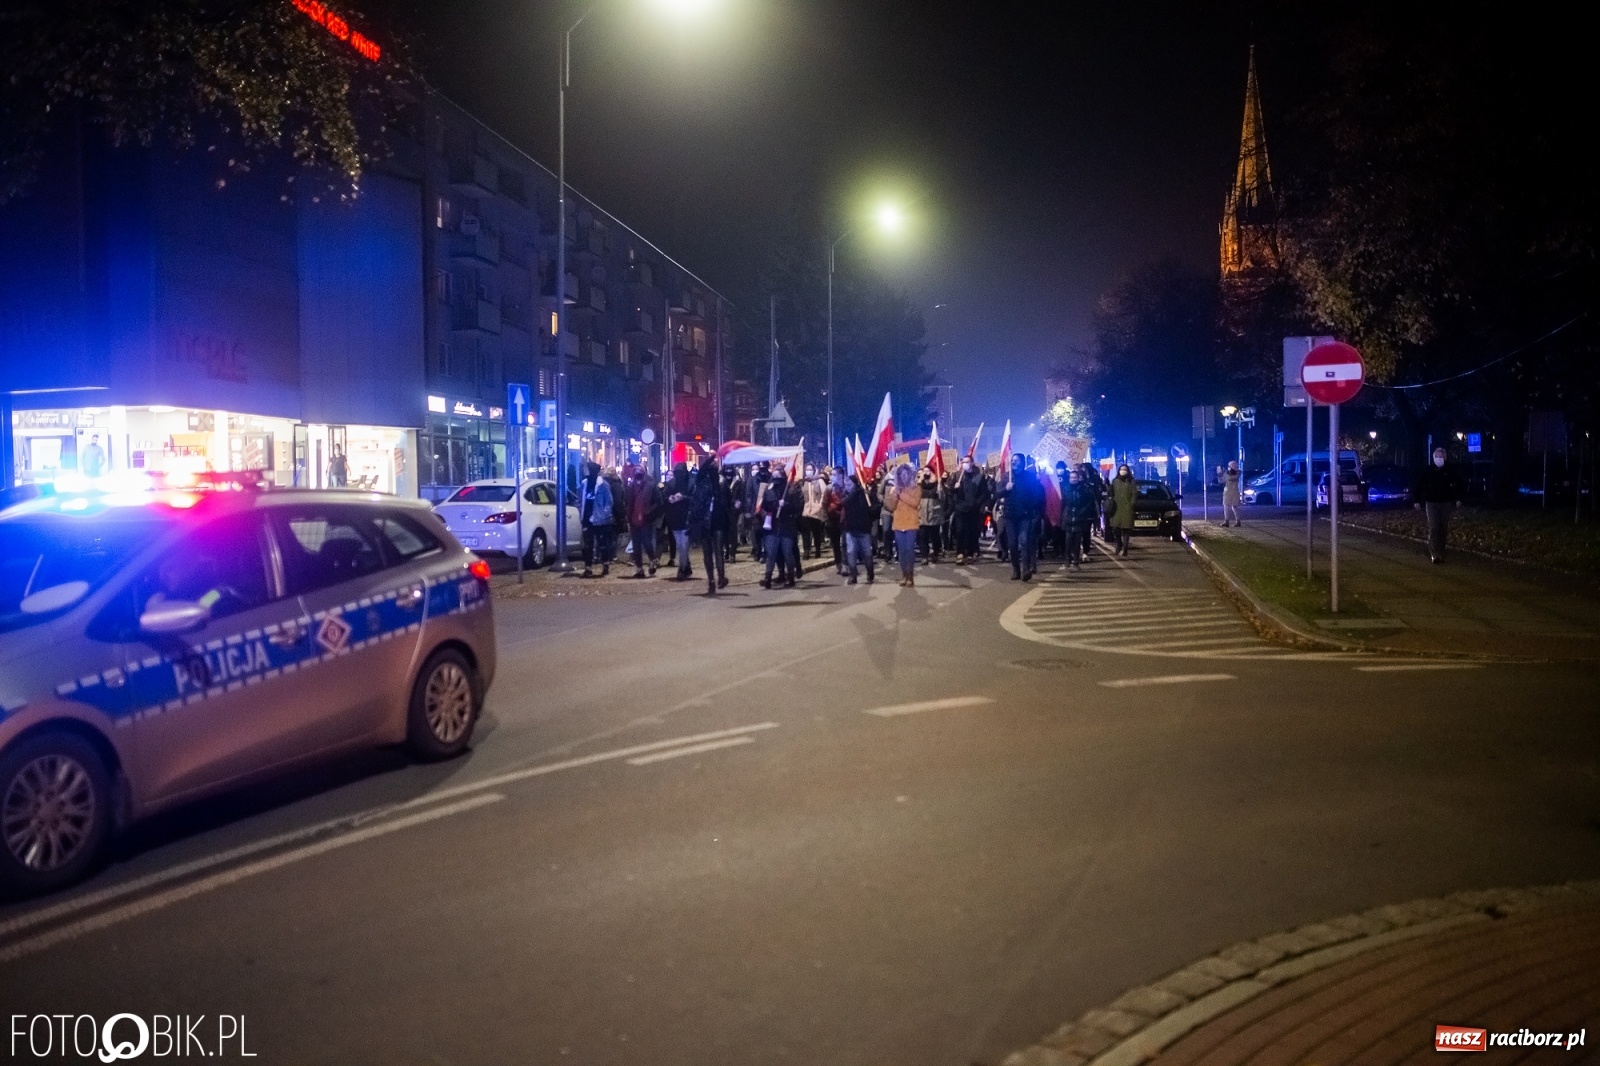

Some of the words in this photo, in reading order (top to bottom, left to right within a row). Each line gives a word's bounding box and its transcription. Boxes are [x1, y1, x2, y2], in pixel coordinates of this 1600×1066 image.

[327, 12, 349, 41] RED
[351, 31, 381, 62] WHITE
[31, 415, 60, 424] komfort
[172, 641, 271, 694] POLICJA
